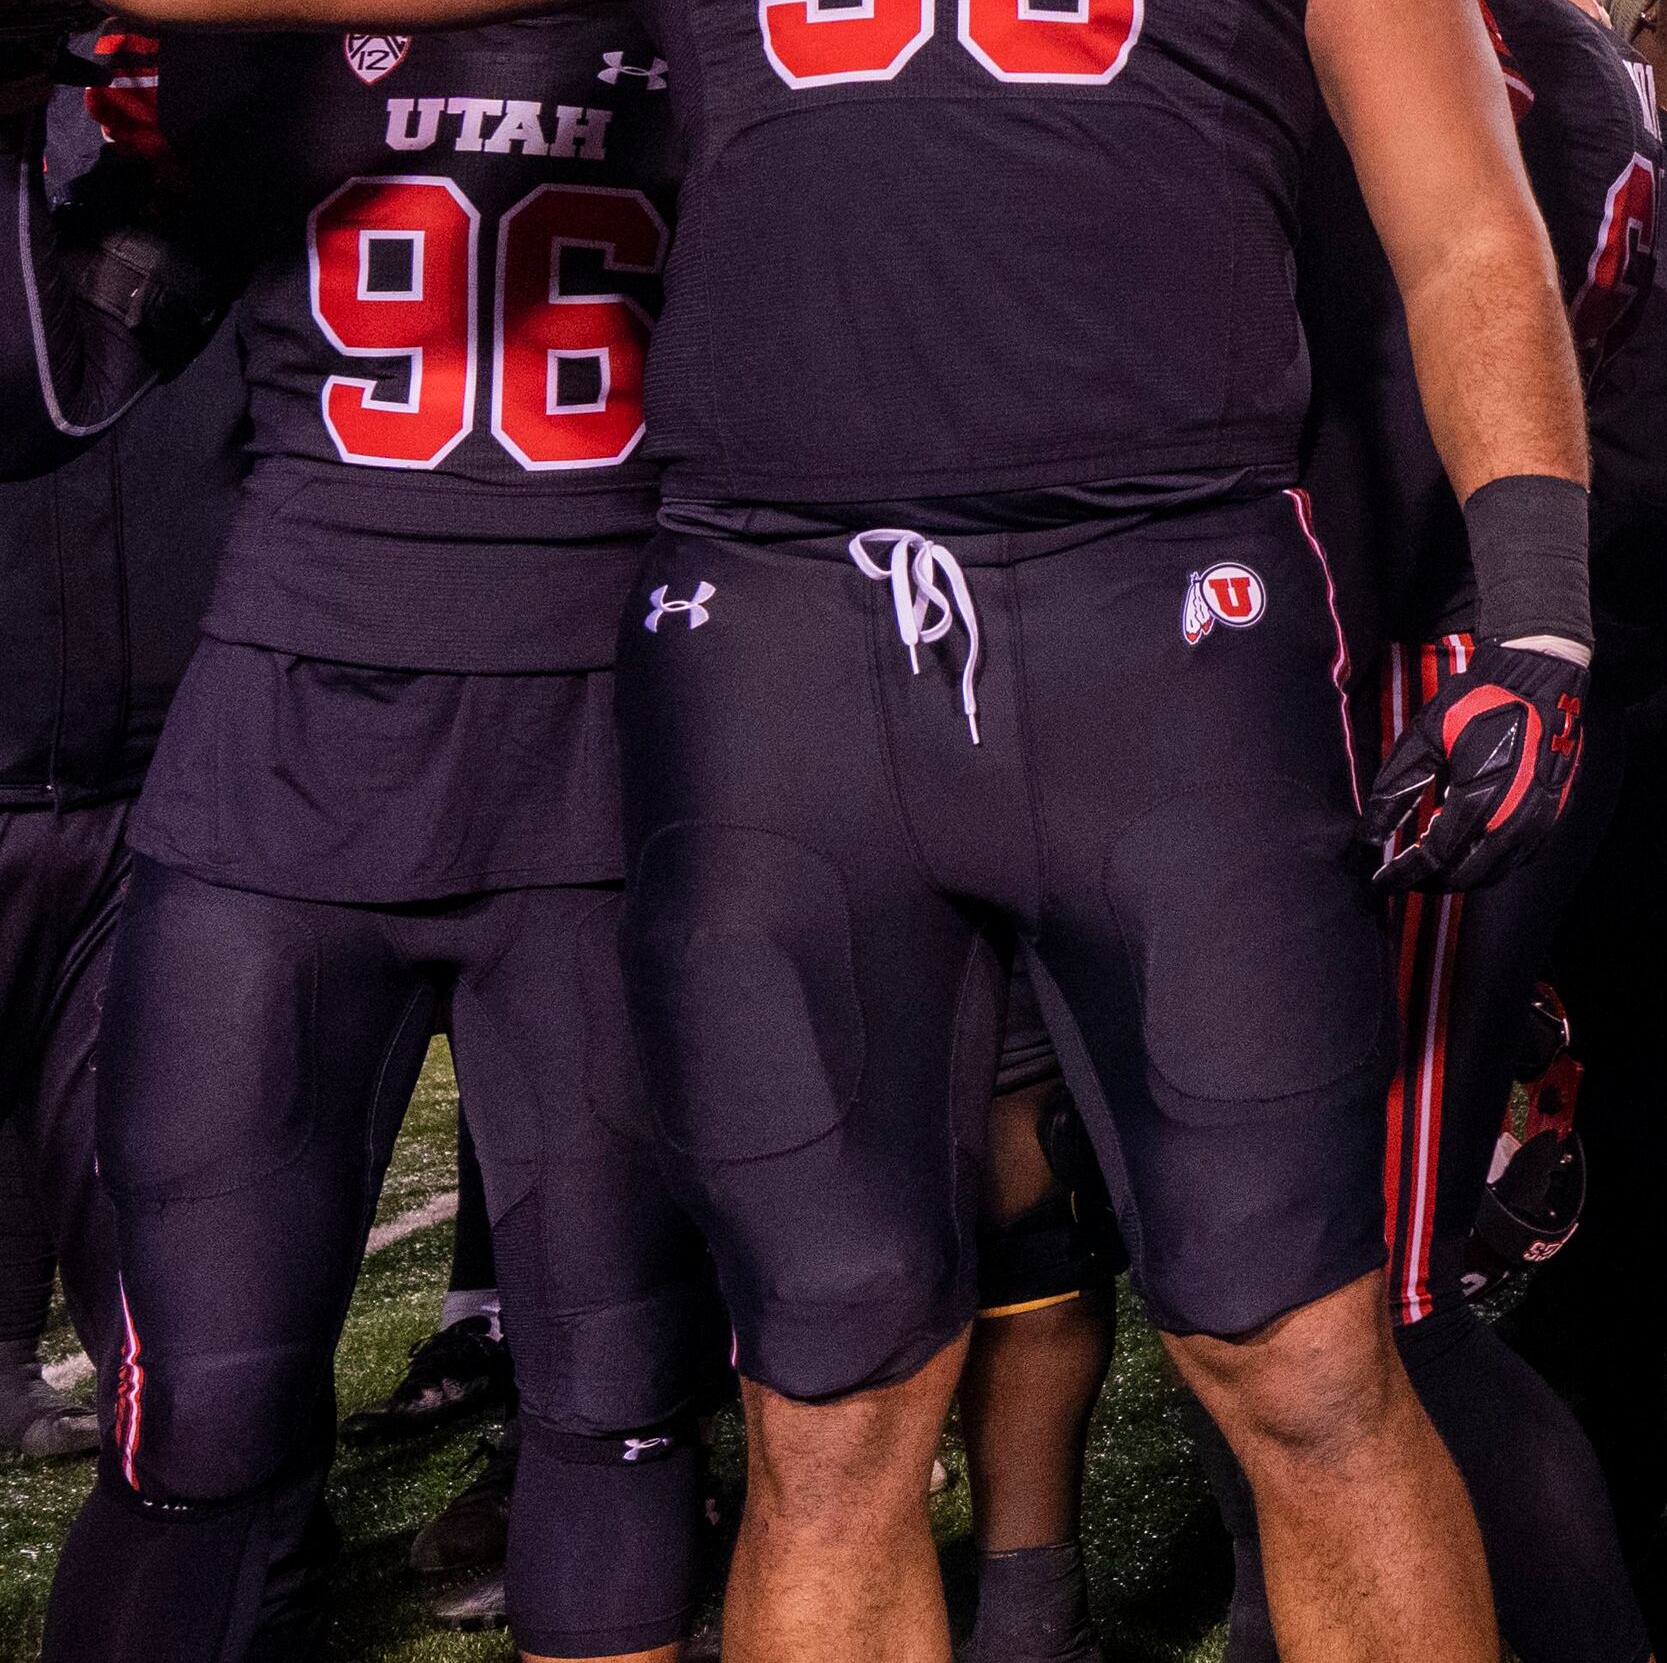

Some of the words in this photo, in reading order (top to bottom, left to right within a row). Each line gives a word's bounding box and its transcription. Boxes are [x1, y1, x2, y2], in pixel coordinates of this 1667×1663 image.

[357, 49, 391, 71] 12
[385, 97, 613, 161] UTAH
[306, 175, 670, 472] 96
